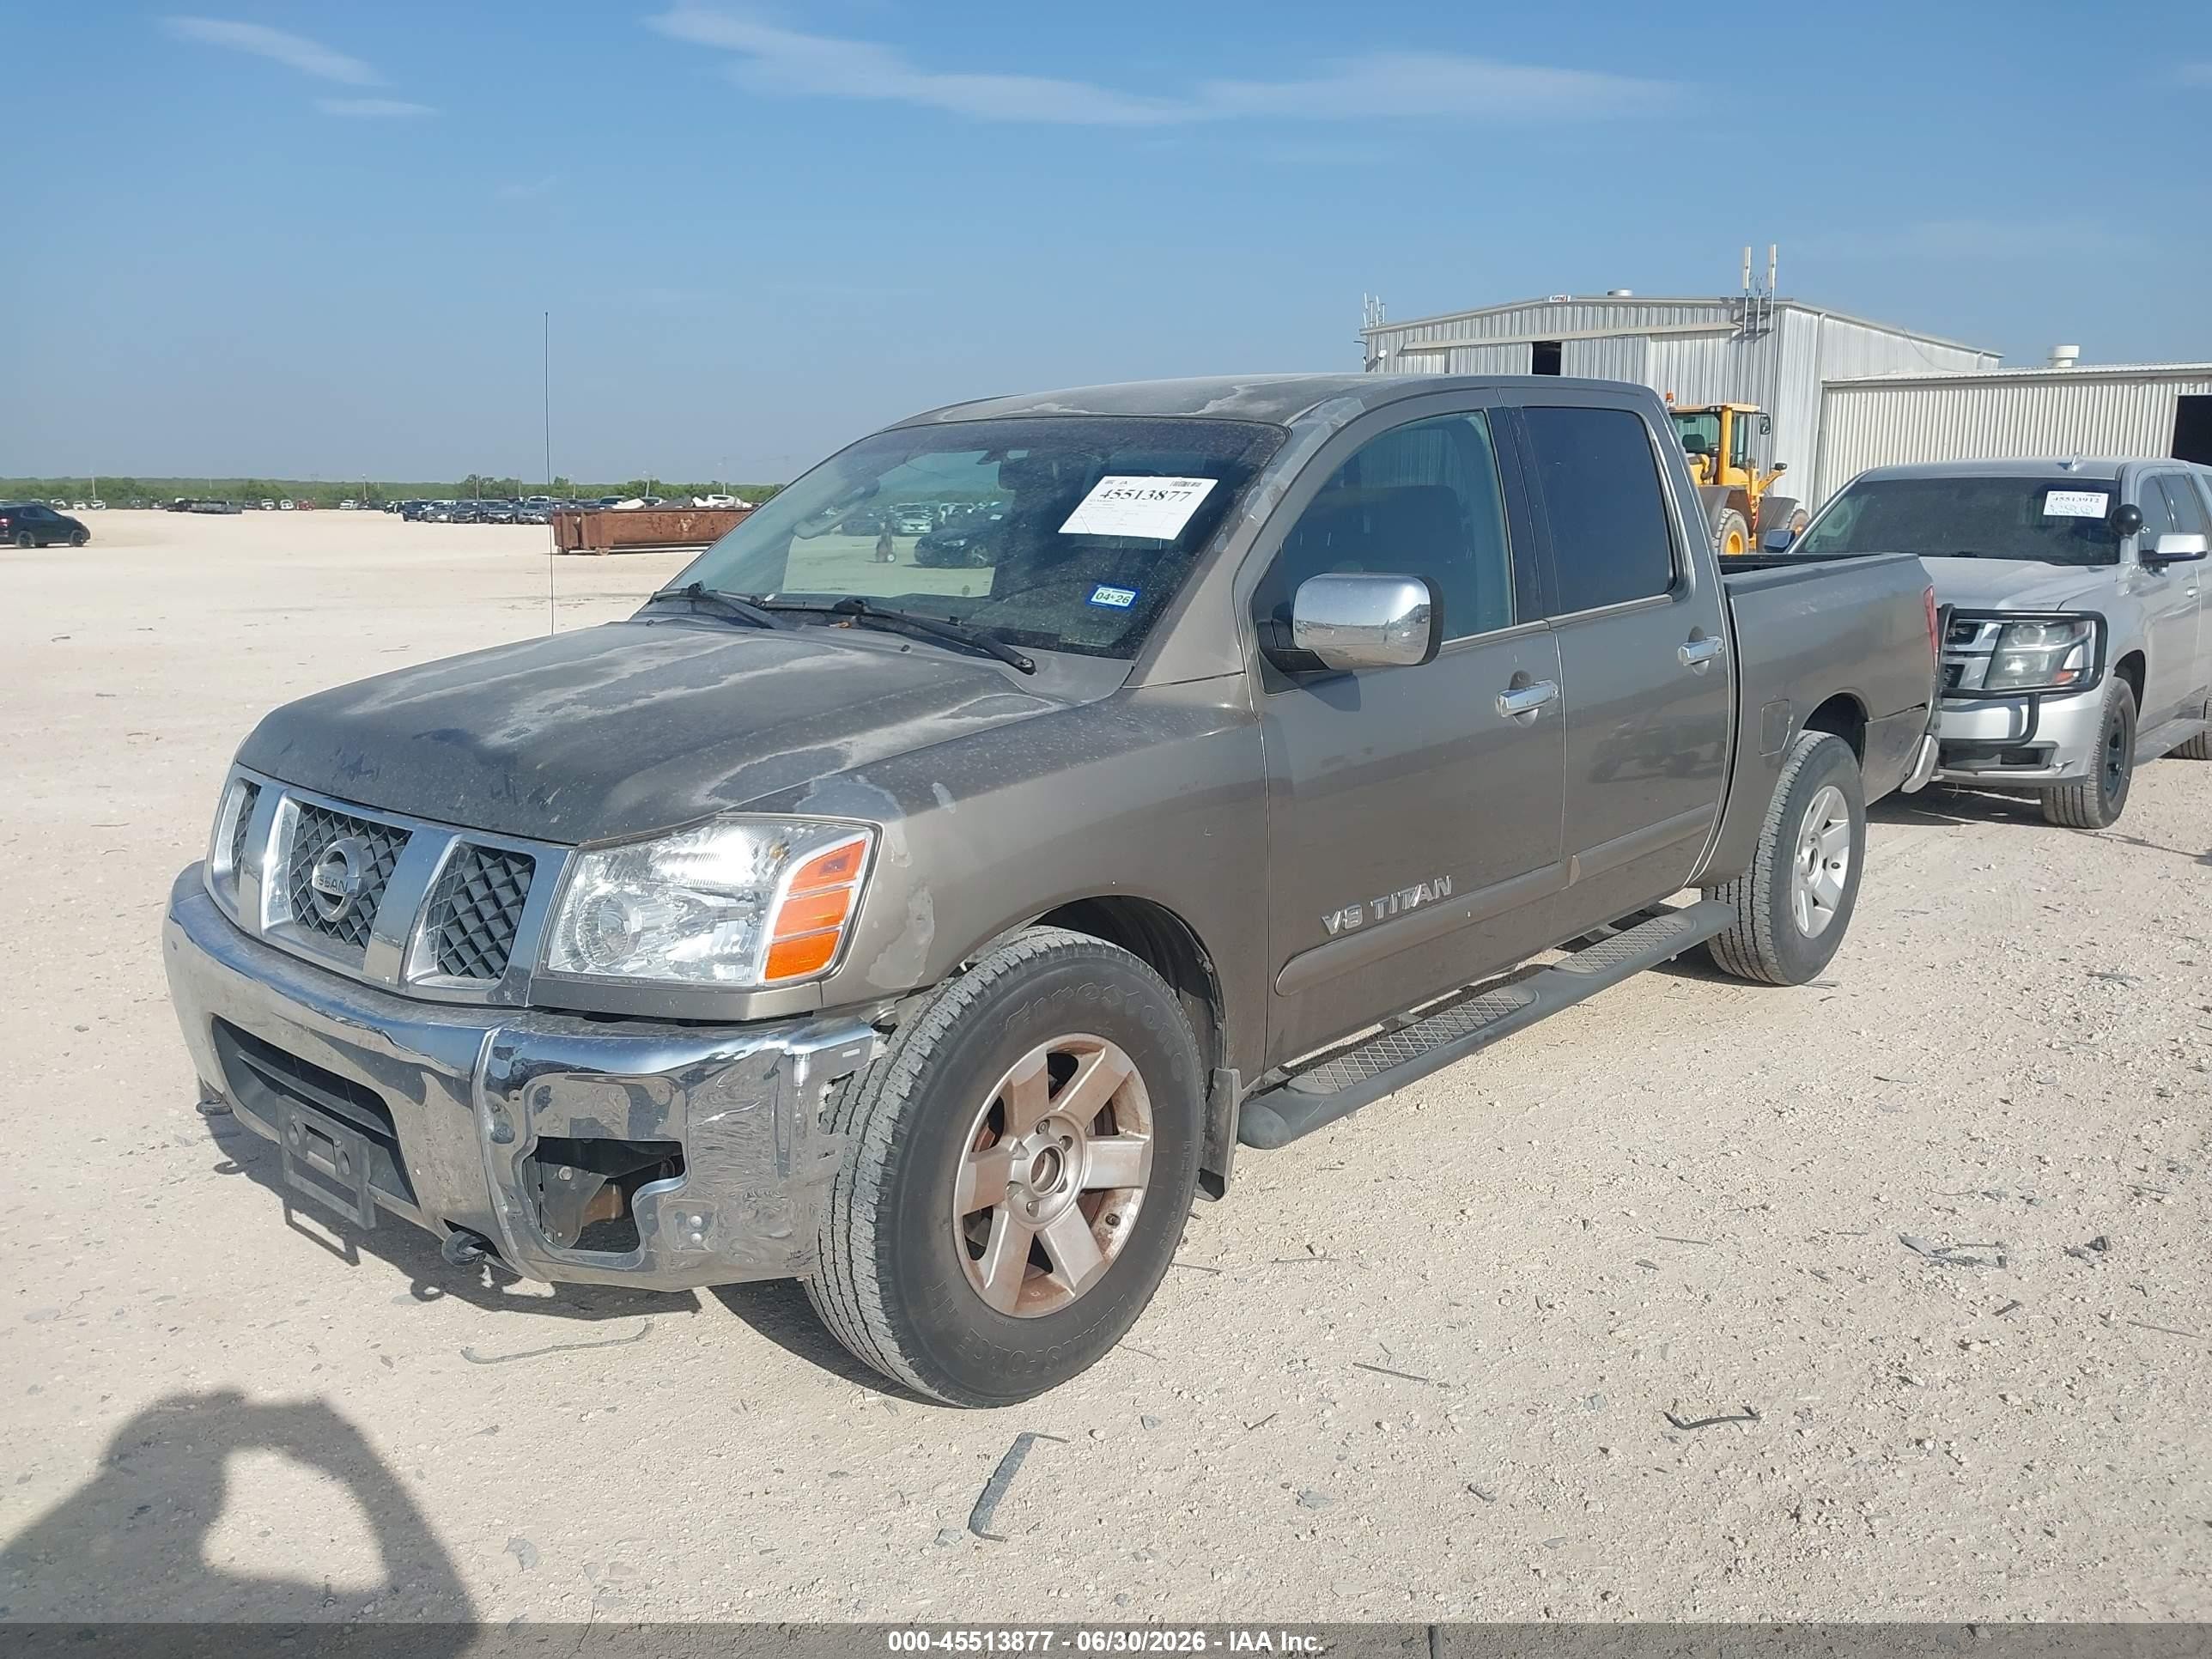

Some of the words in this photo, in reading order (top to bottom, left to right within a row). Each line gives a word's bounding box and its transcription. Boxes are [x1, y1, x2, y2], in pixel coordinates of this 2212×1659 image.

[1100, 489, 1192, 502] 45513877
[1321, 903, 1364, 936] V8
[1370, 875, 1452, 921] TITAN
